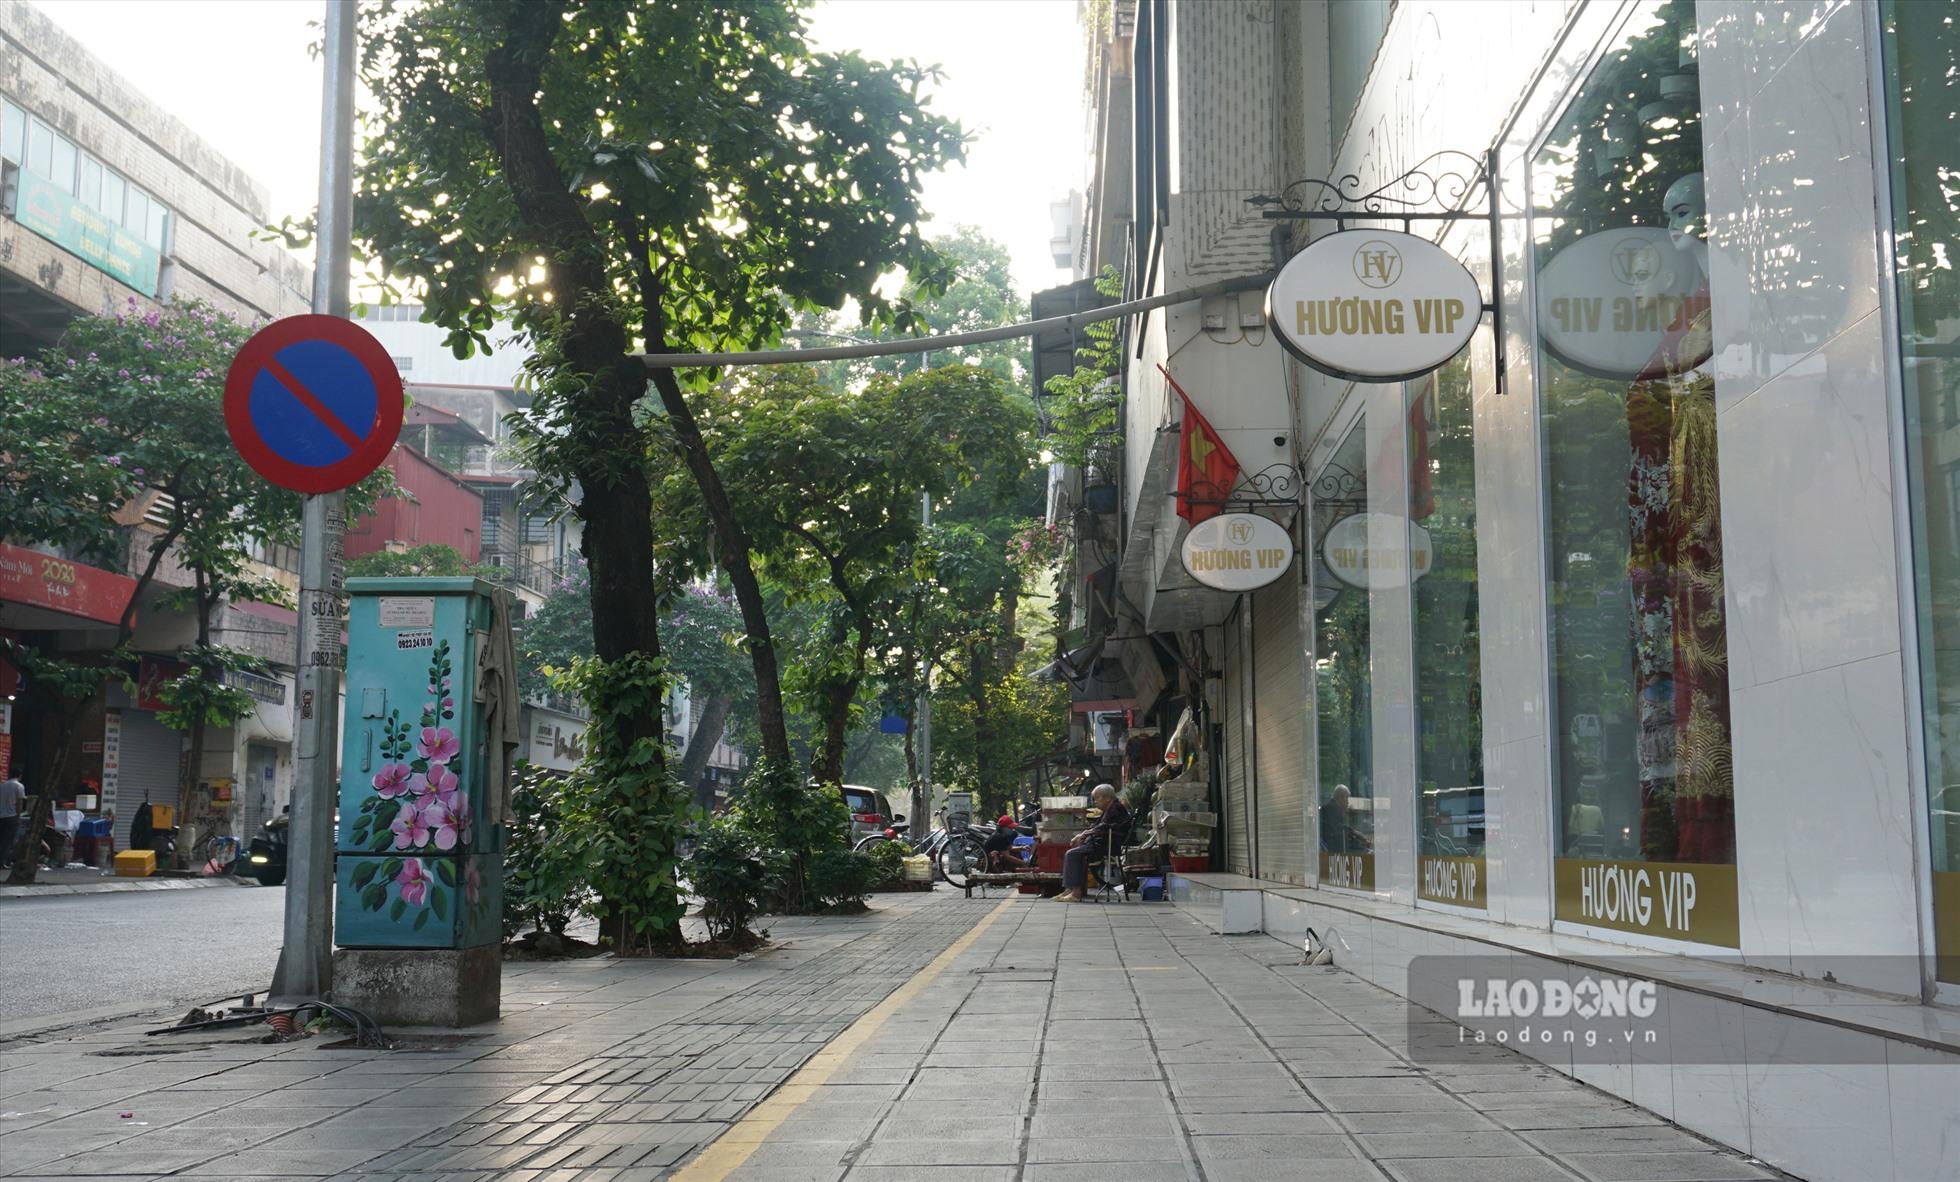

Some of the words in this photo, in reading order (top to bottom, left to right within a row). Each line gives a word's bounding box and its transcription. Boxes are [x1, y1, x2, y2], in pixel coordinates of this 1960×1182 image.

[1296, 296, 1405, 336] HƯƠNG
[1413, 299, 1465, 334] VIP
[41, 558, 76, 584] 2023
[1191, 549, 1252, 571] HƯƠNG
[1256, 548, 1286, 569] VIP
[1351, 856, 1363, 888] VIP
[1424, 859, 1458, 900] HƯƠNG
[1459, 862, 1477, 901] VIP
[1581, 863, 1652, 927] HƯƠNG
[1658, 870, 1697, 932] VIP
